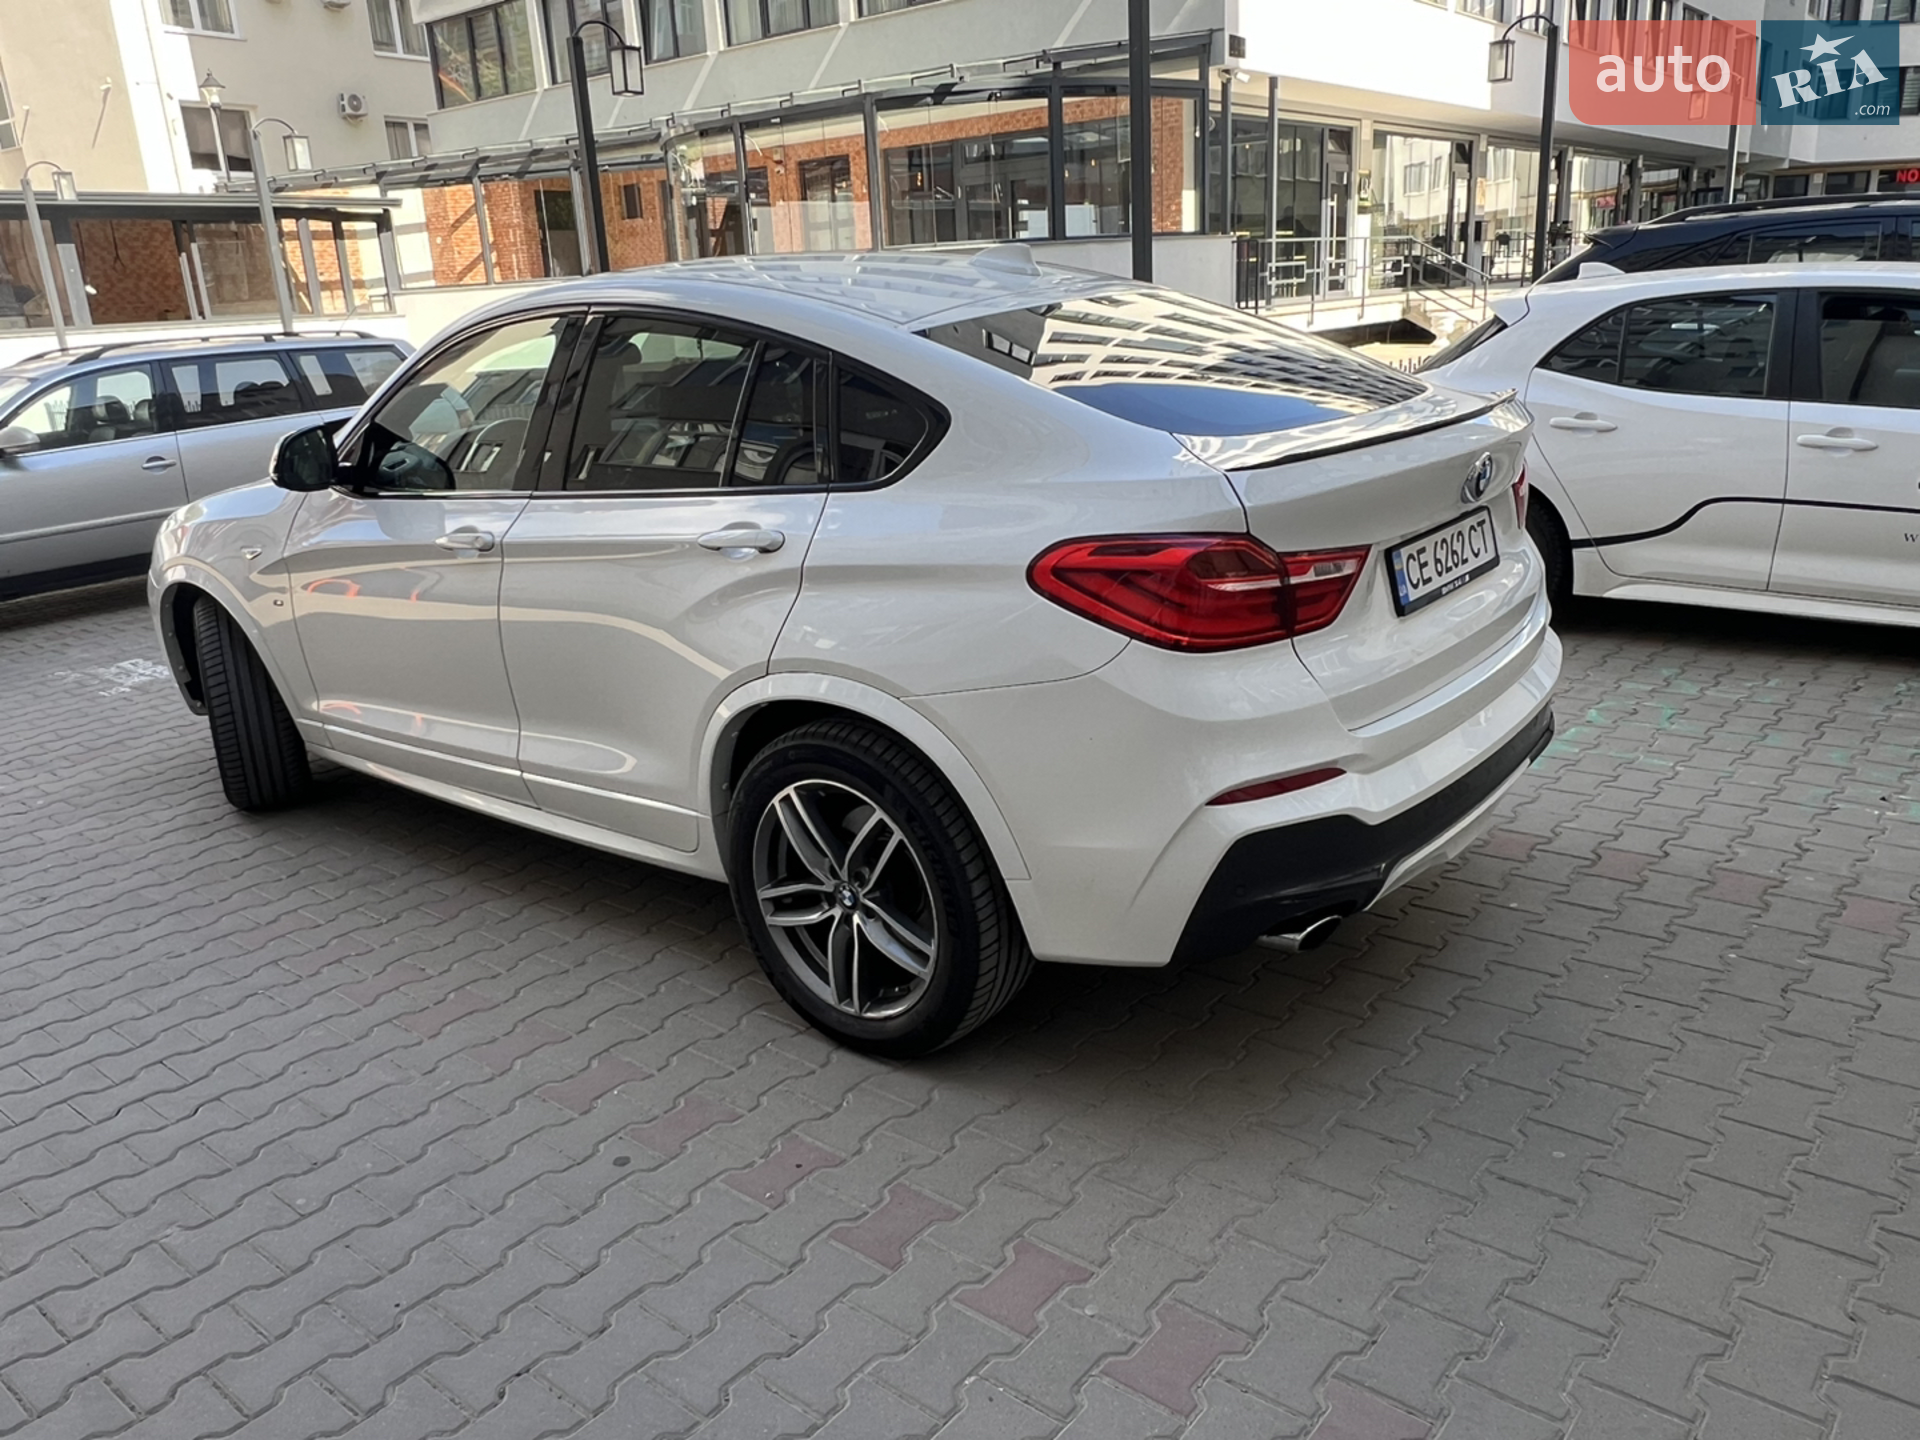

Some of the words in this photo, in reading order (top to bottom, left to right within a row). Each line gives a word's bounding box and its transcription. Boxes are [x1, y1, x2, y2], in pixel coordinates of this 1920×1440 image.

[1406, 546, 1432, 590] CE
[1433, 530, 1469, 577] 6262
[1468, 519, 1488, 559] CT
